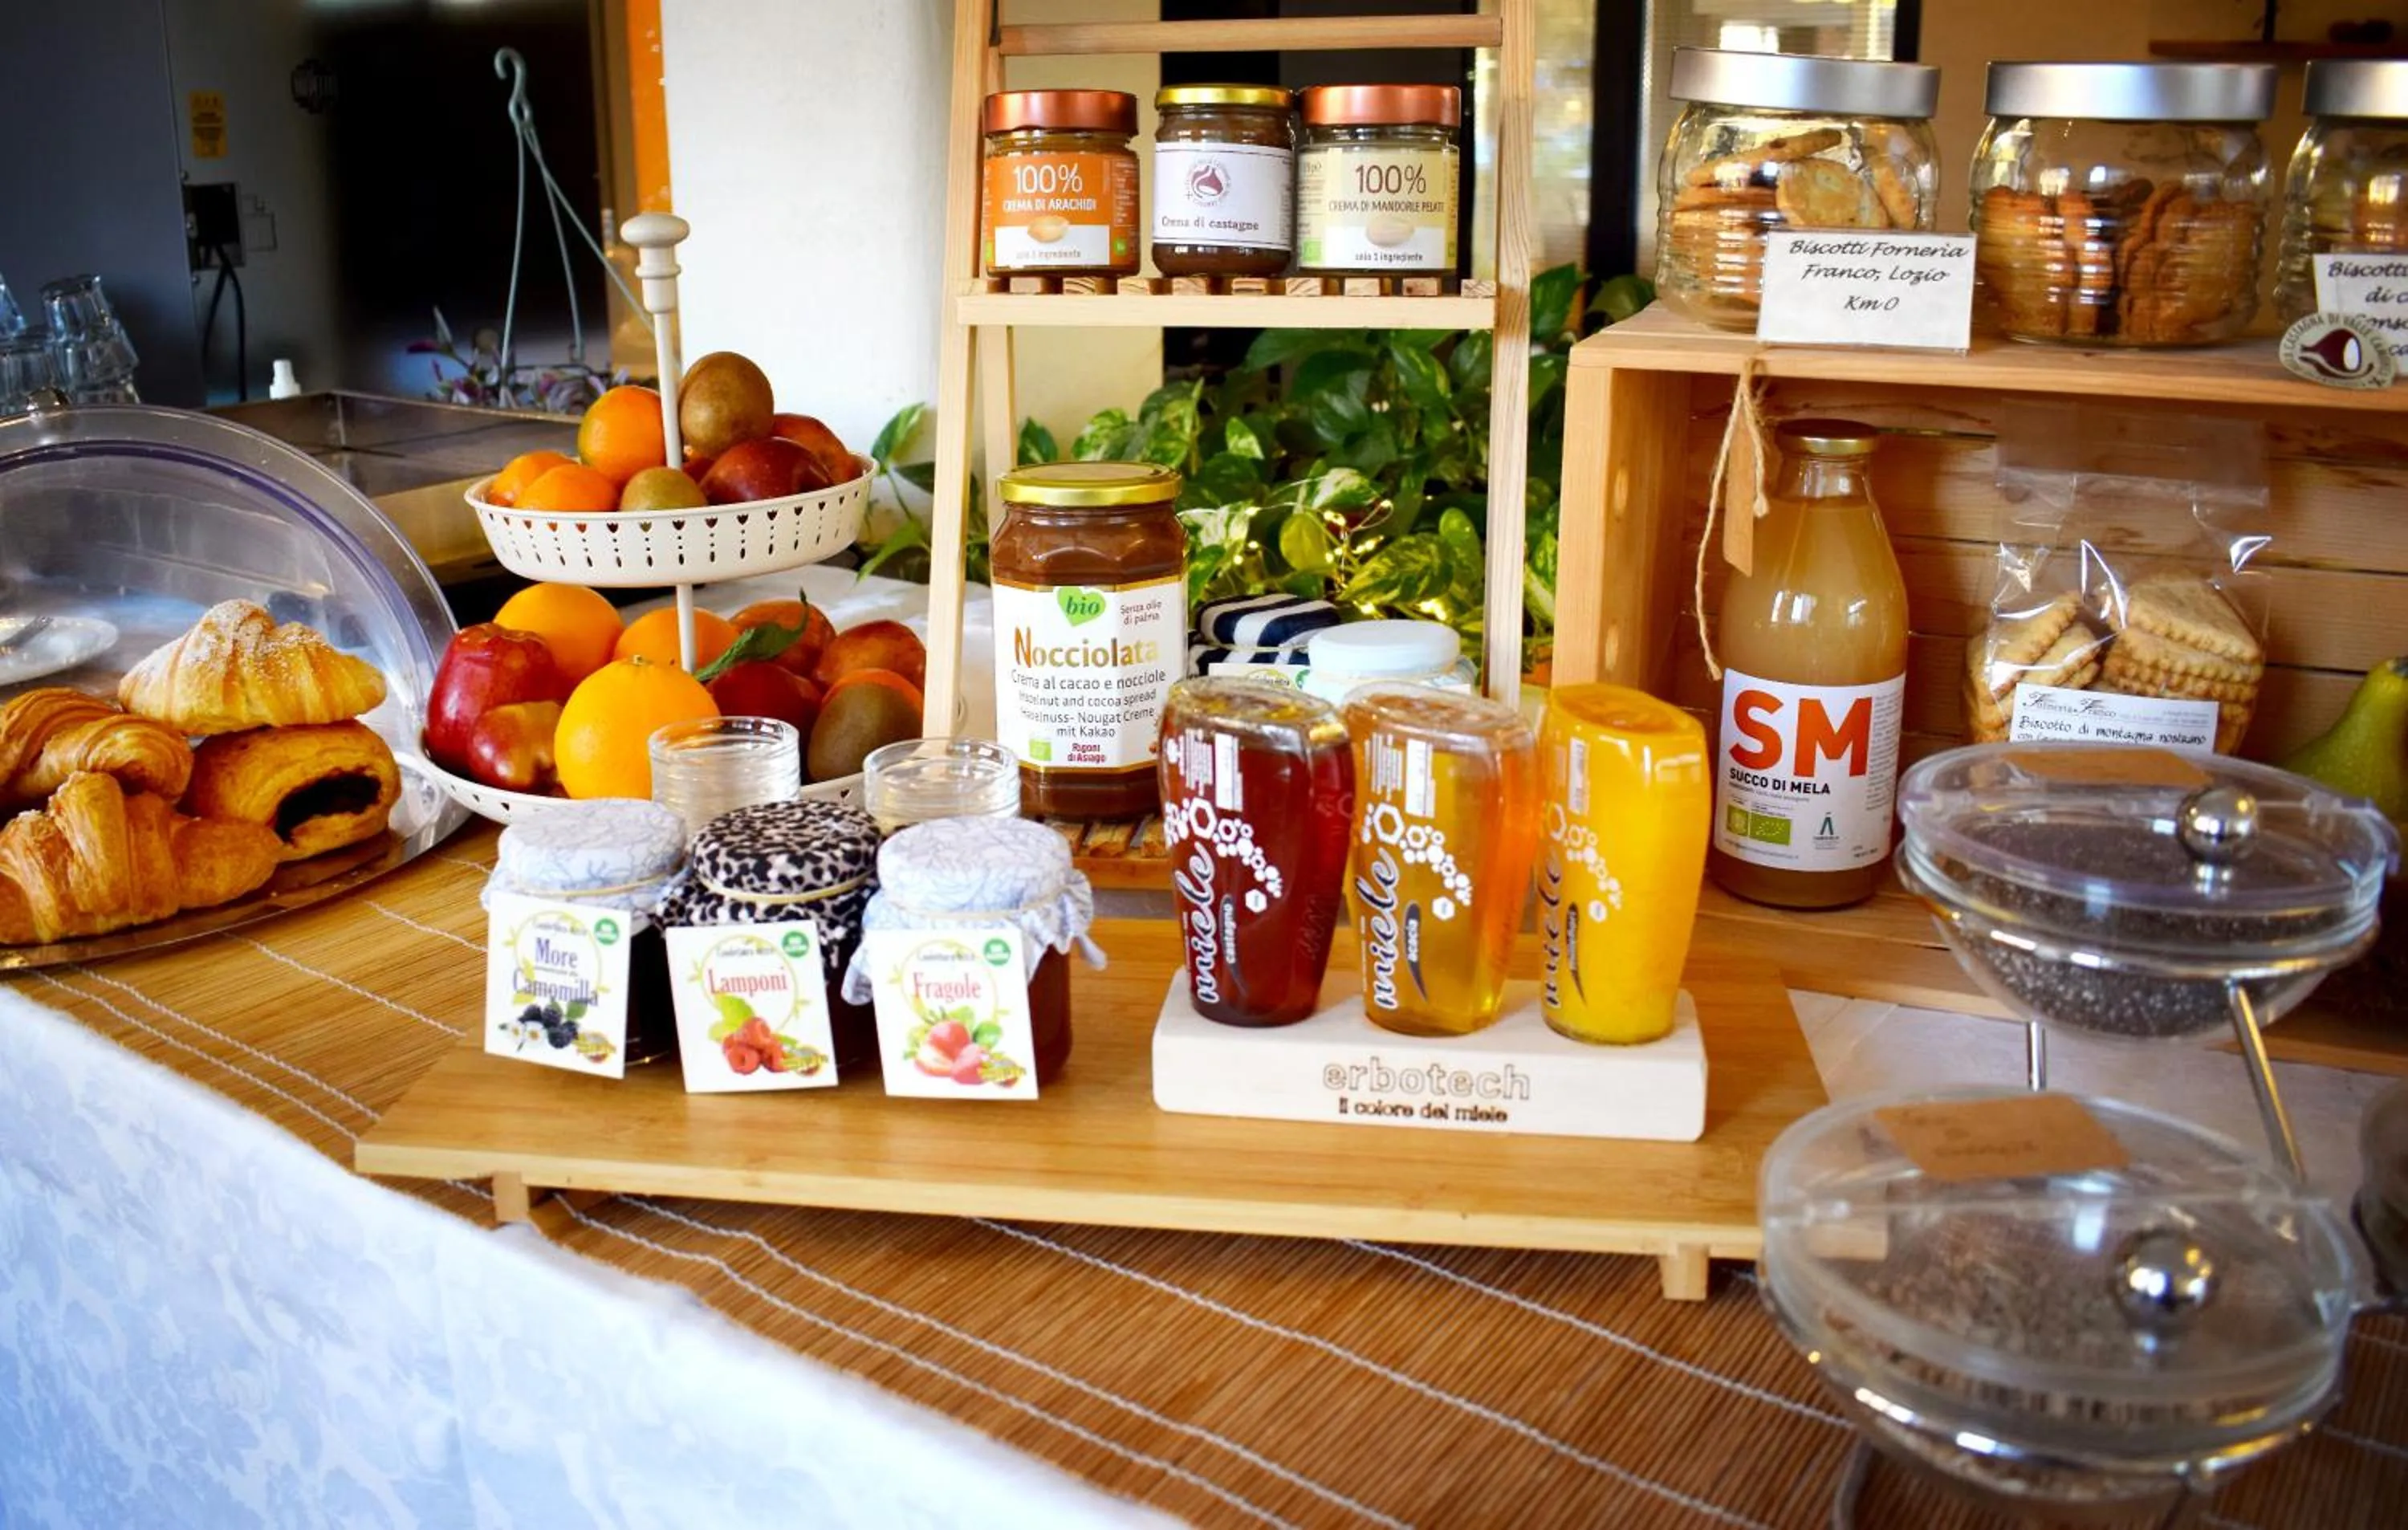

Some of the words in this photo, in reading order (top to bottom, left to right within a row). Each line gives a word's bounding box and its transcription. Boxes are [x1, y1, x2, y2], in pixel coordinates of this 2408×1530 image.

[1013, 163, 1083, 193] 100%
[1355, 164, 1426, 194] 100%
[1003, 198, 1033, 211] CREMA
[1035, 198, 1045, 210] DI
[1049, 198, 1096, 210] ARACHIDI
[1328, 201, 1359, 212] CREMA
[1361, 201, 1369, 212] DI
[1371, 201, 1420, 213] MANDORLE
[1161, 216, 1190, 228] Crema
[1194, 216, 1205, 228] di
[1208, 220, 1259, 232] castagne
[1380, 251, 1423, 262] ingrediente
[1789, 240, 1870, 256] Biscotti
[1869, 241, 1969, 258] Forneria
[1801, 263, 1881, 282] Franco,
[1889, 265, 1950, 286] Lozio
[1845, 295, 1884, 311] Km
[2365, 286, 2394, 303] di
[1065, 595, 1100, 616] bio
[1120, 603, 1144, 615] Senza
[1124, 614, 1133, 625] di
[1134, 612, 1161, 626] palma
[1014, 626, 1160, 669] Nocciolata
[1011, 669, 1040, 690] Crema
[1043, 677, 1056, 690] al
[1059, 678, 1100, 690] cacao
[1104, 678, 1112, 690] e
[1117, 669, 1166, 689] nocciole
[1062, 695, 1084, 707] and
[1088, 697, 1122, 707] cocoa
[1123, 689, 1157, 706] spread
[1078, 712, 1122, 726] Nougat
[1123, 706, 1155, 722] Creme
[1056, 726, 1076, 738] mit
[1080, 726, 1117, 738] Kakao
[1729, 689, 1873, 778] SM
[2019, 715, 2072, 732] Biscotto
[2078, 723, 2089, 734] di
[2096, 726, 2154, 743] montagna
[1072, 743, 1100, 753] Rigoni
[1076, 753, 1105, 763] Asiago
[1730, 768, 1769, 788] SUCCO
[1772, 779, 1785, 792] DI
[1790, 782, 1831, 795] MELA
[1175, 841, 1219, 1003] miele
[1354, 848, 1401, 1010] miele
[535, 937, 578, 968] More
[513, 967, 599, 1007] Camomilla
[708, 966, 788, 998] Lamponi
[913, 972, 981, 1003] Fragole
[1324, 1056, 1530, 1100] erbotech
[1354, 1100, 1414, 1118] colore
[1454, 1105, 1508, 1122] miele
